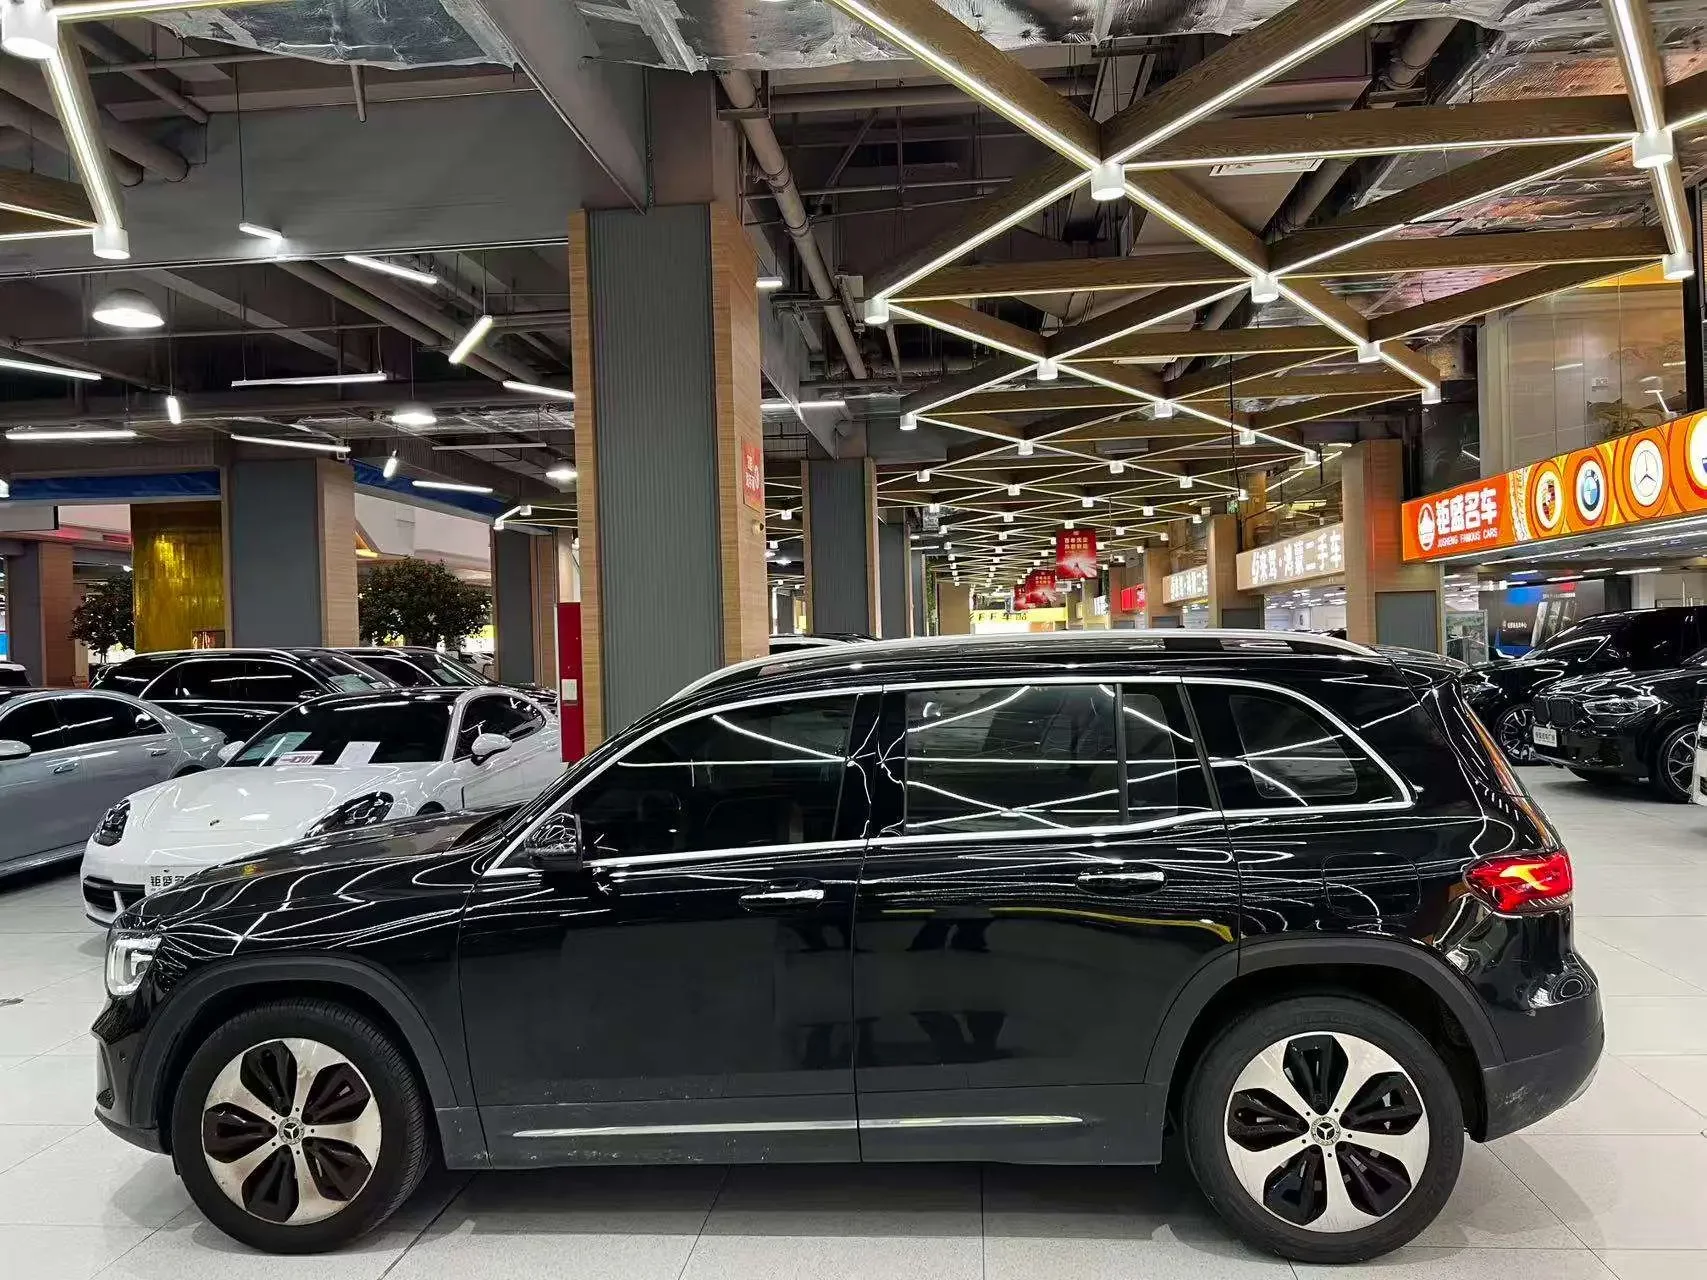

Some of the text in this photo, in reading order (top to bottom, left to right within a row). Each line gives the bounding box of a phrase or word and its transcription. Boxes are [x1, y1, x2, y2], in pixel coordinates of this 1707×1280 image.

[1437, 527, 1498, 548] JUSHENG FAMOUS CARS
